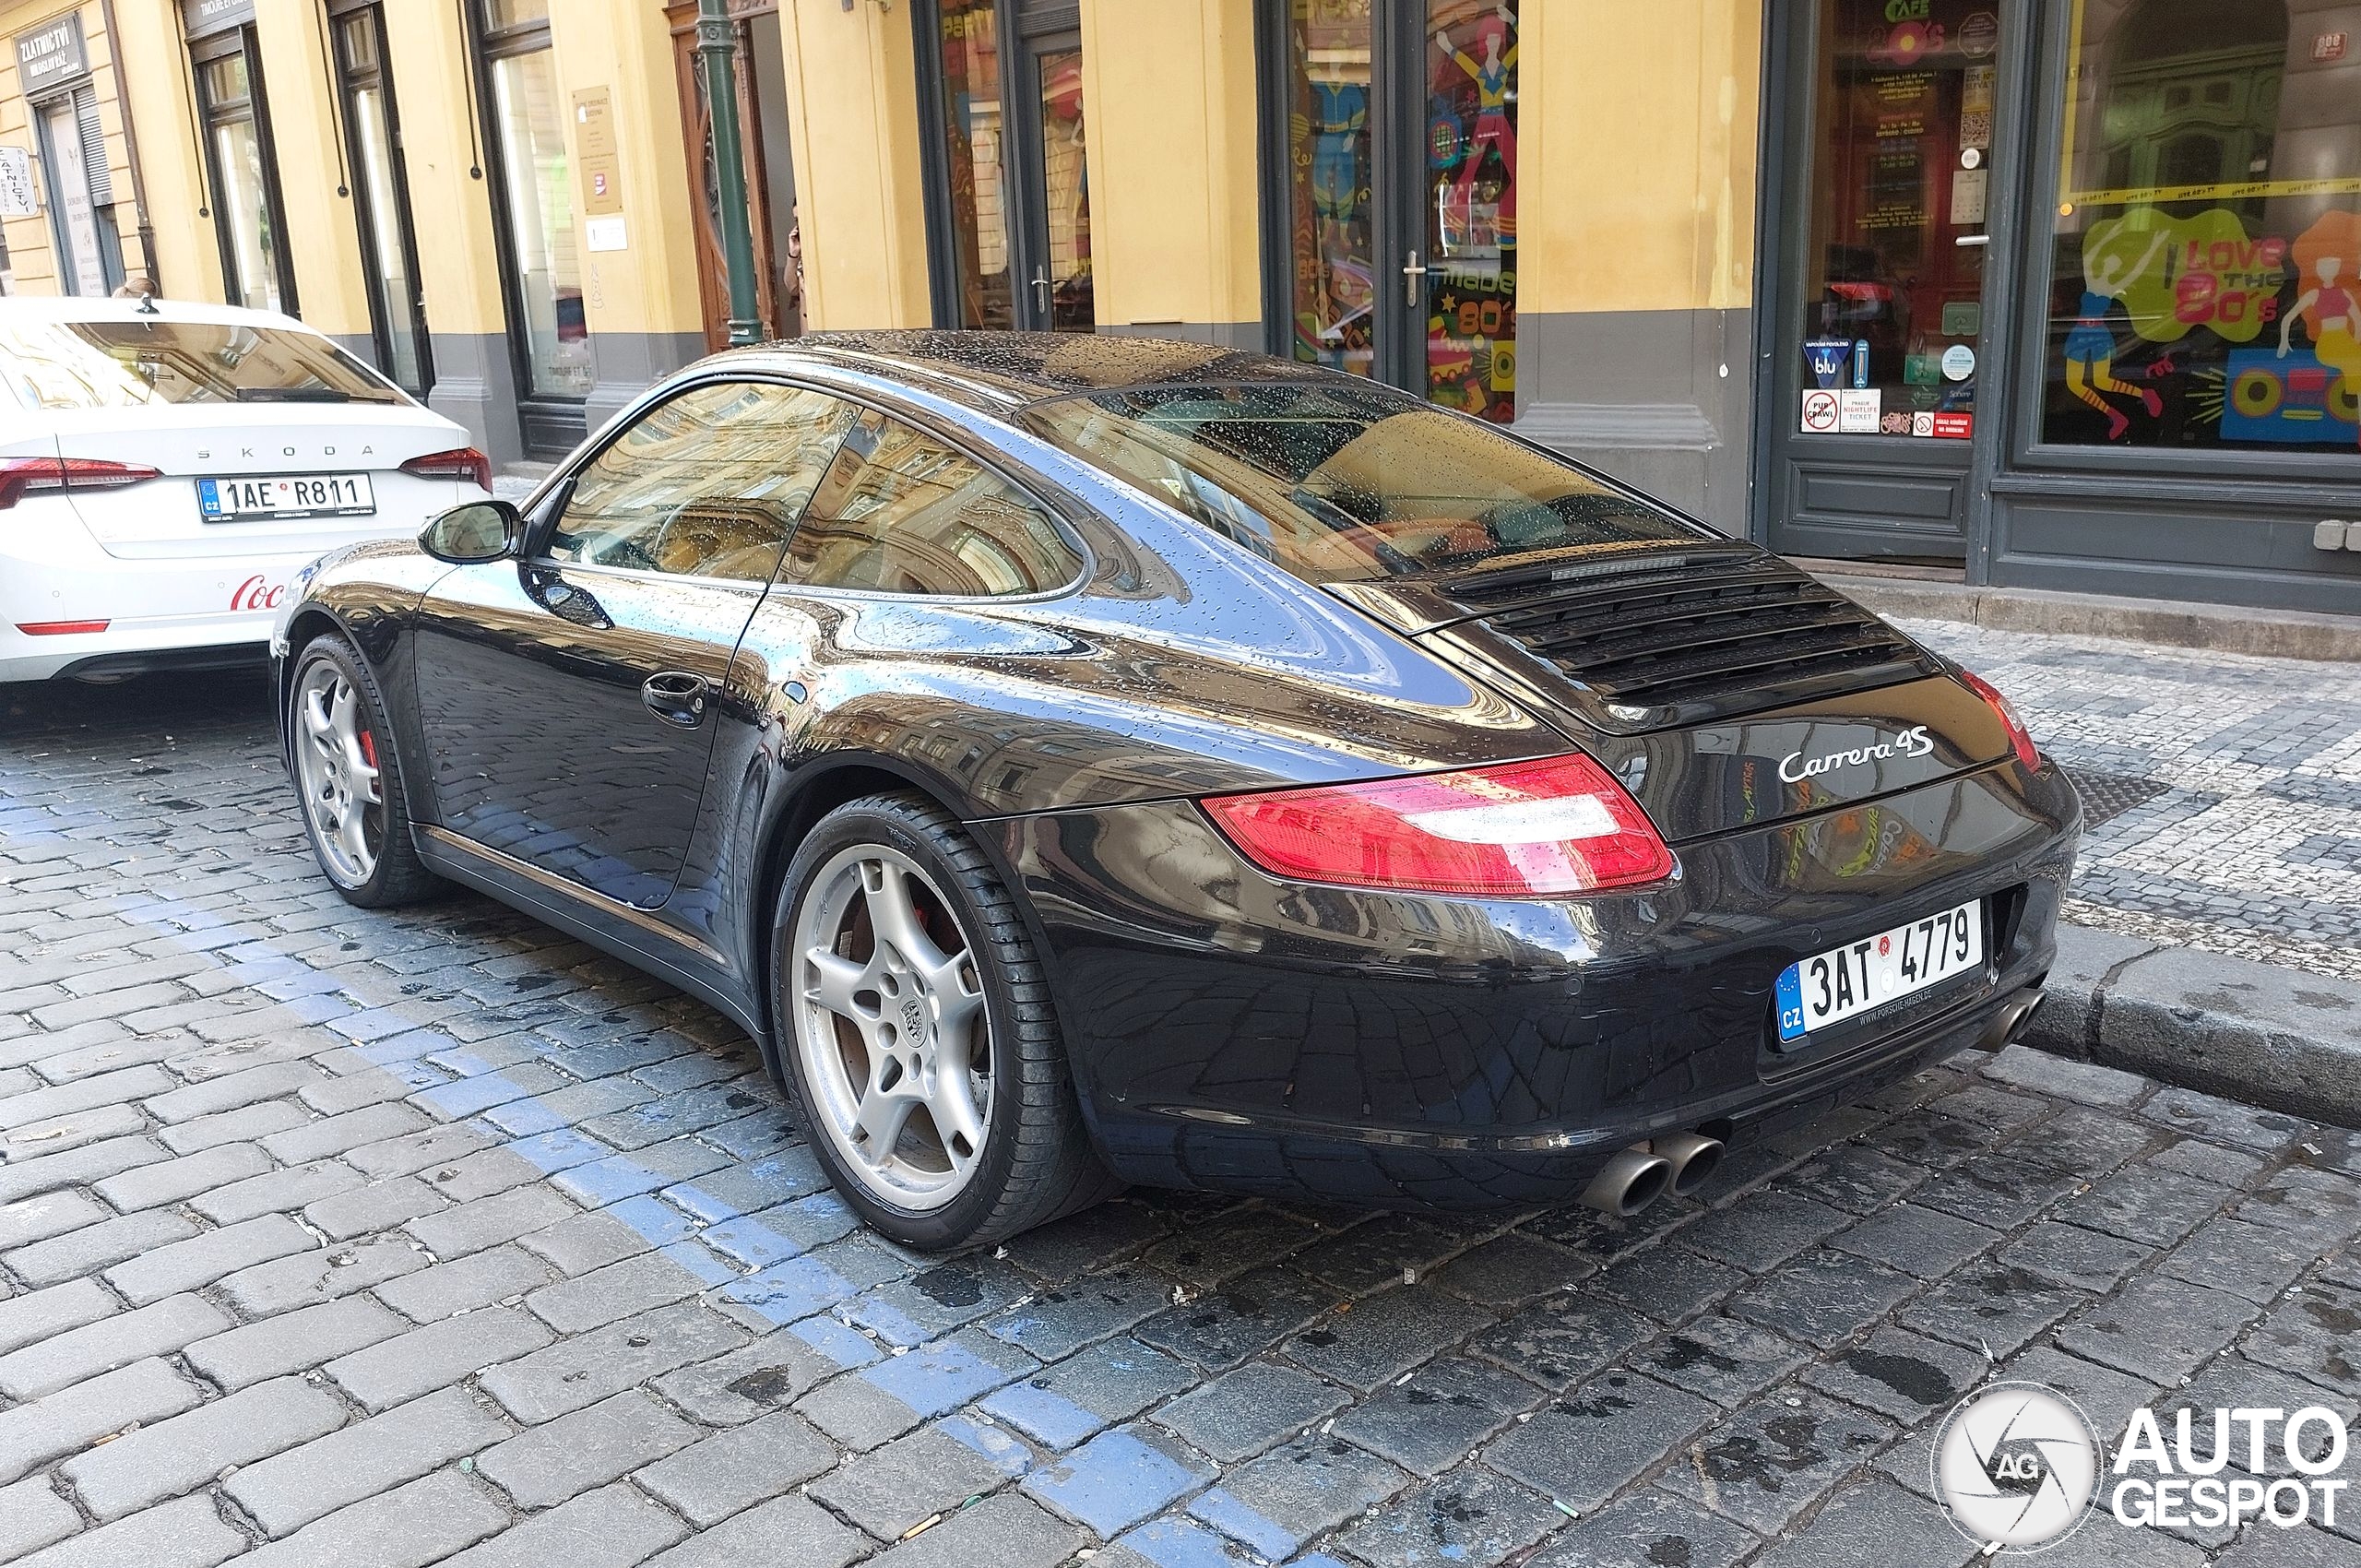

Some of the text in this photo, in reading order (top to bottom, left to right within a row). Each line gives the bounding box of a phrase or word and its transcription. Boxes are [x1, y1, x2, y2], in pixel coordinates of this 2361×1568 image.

[1815, 356, 1837, 374] blu
[206, 502, 219, 511] CZ
[228, 479, 359, 509] 1AE R811
[1778, 725, 1935, 784] Carrera 4S
[1809, 908, 1969, 1017] 3AT 4779
[1783, 1006, 1802, 1029] CZ
[1859, 989, 1932, 1026] WWW.PORSCHE-HAGEN.DE
